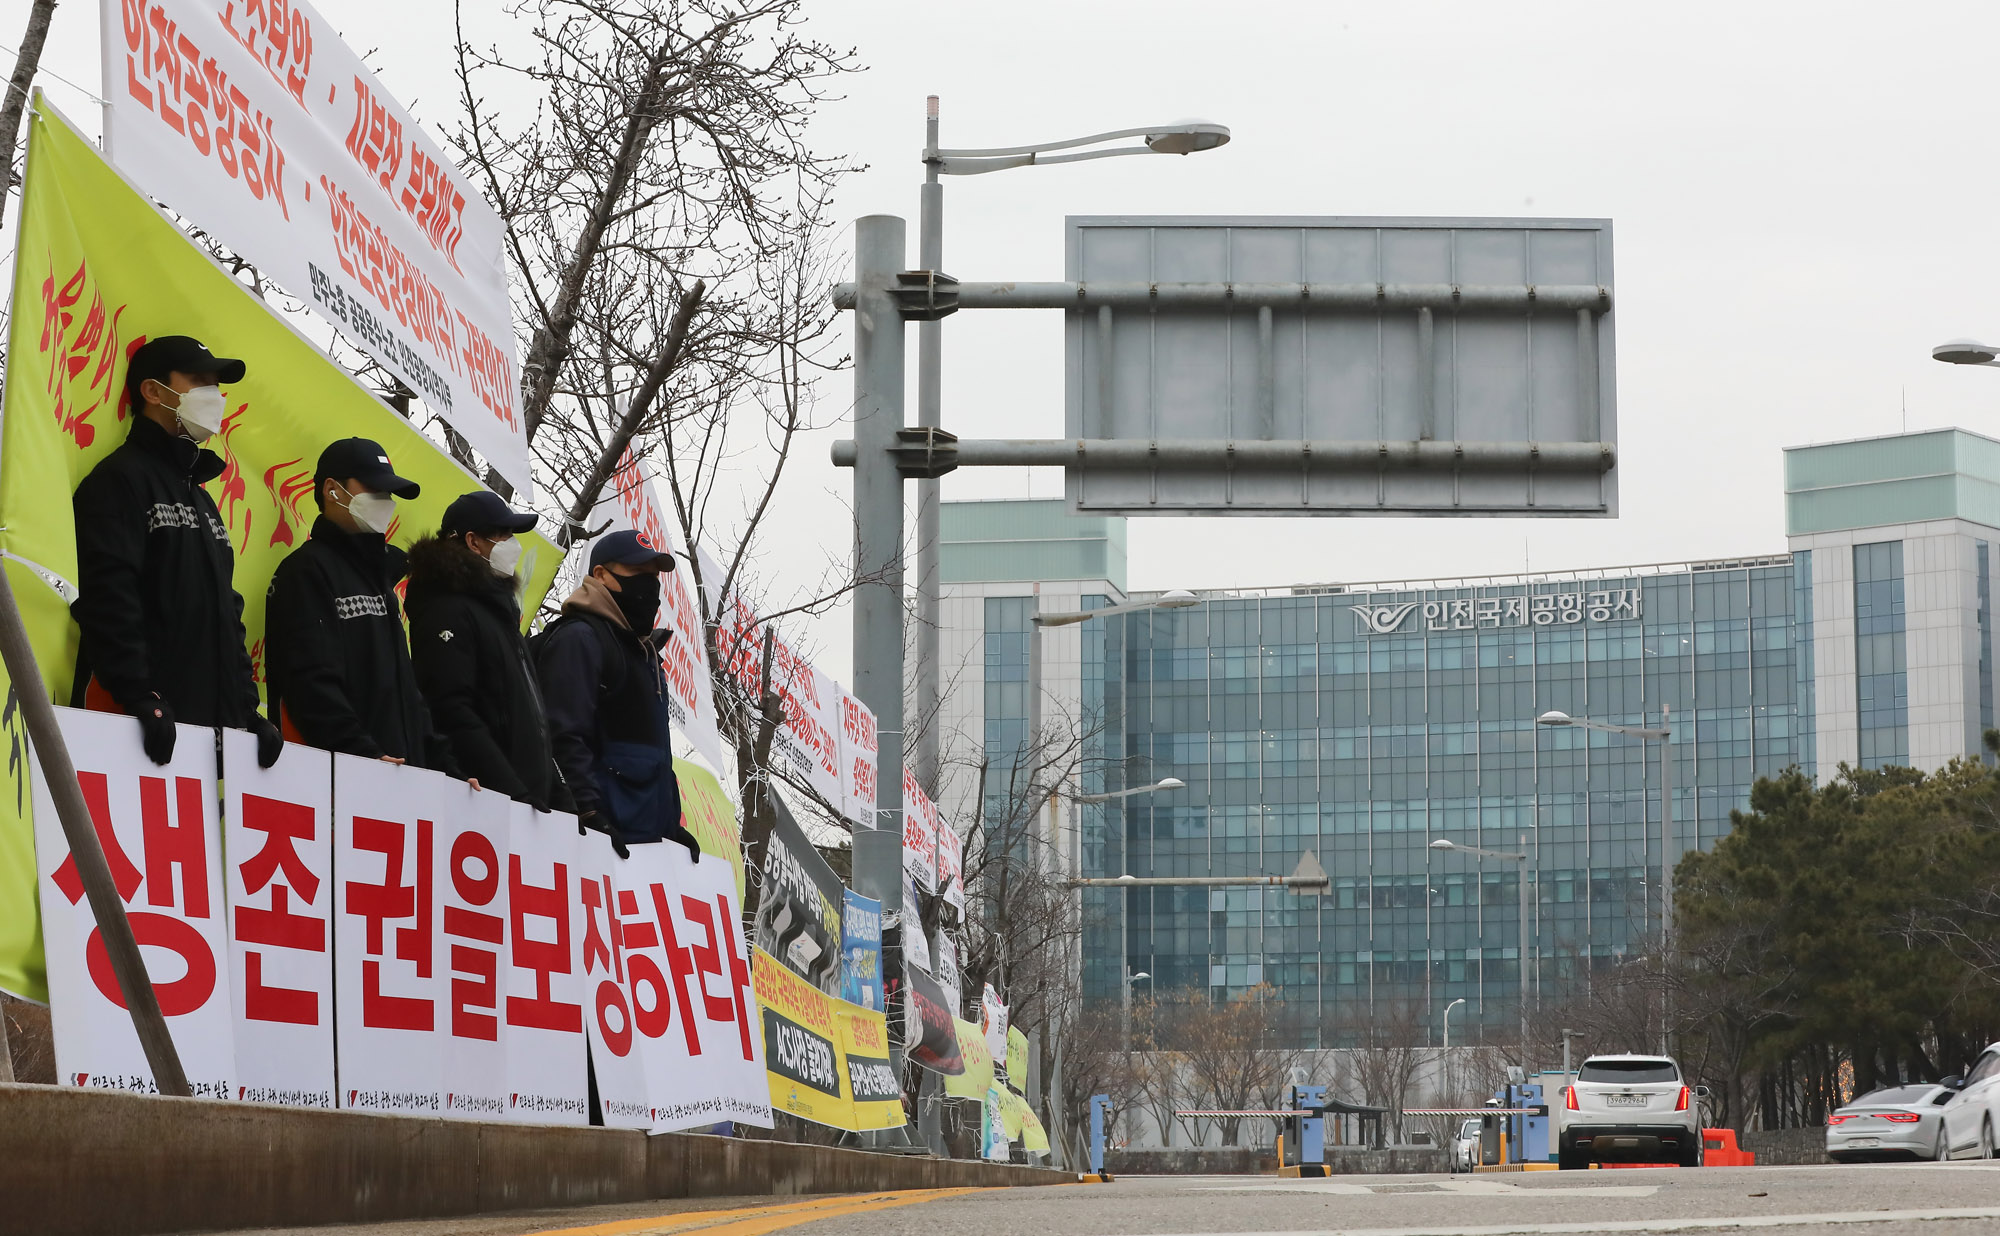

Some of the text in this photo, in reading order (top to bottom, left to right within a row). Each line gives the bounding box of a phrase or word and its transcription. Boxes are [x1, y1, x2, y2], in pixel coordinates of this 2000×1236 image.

[119, 0, 290, 223] 인천공항공사
[218, 0, 313, 117] 조탄압
[345, 74, 402, 212] 지부장
[308, 261, 453, 415] 민주노총 공공운수노조 인천공항지역지부
[1423, 589, 1641, 632] 인천국제공항공사
